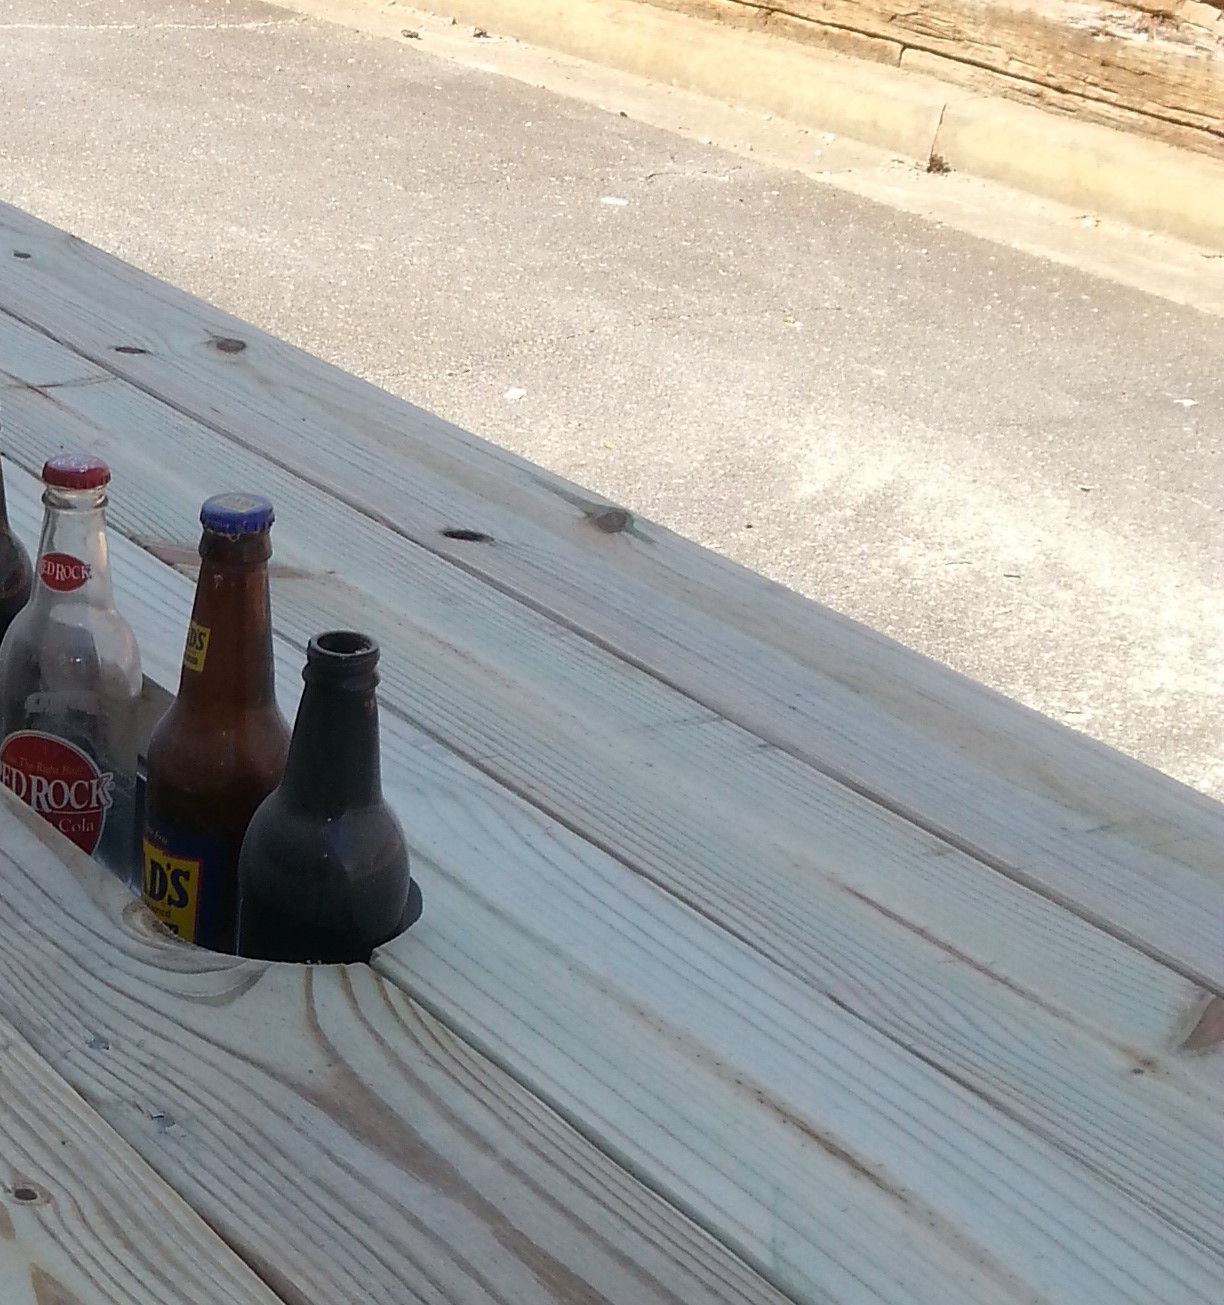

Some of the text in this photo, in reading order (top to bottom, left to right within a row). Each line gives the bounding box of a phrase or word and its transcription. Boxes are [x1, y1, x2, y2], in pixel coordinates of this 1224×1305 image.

[56, 561, 93, 581] ROCK
[28, 773, 115, 813] ROCK
[58, 817, 95, 833] Cola
